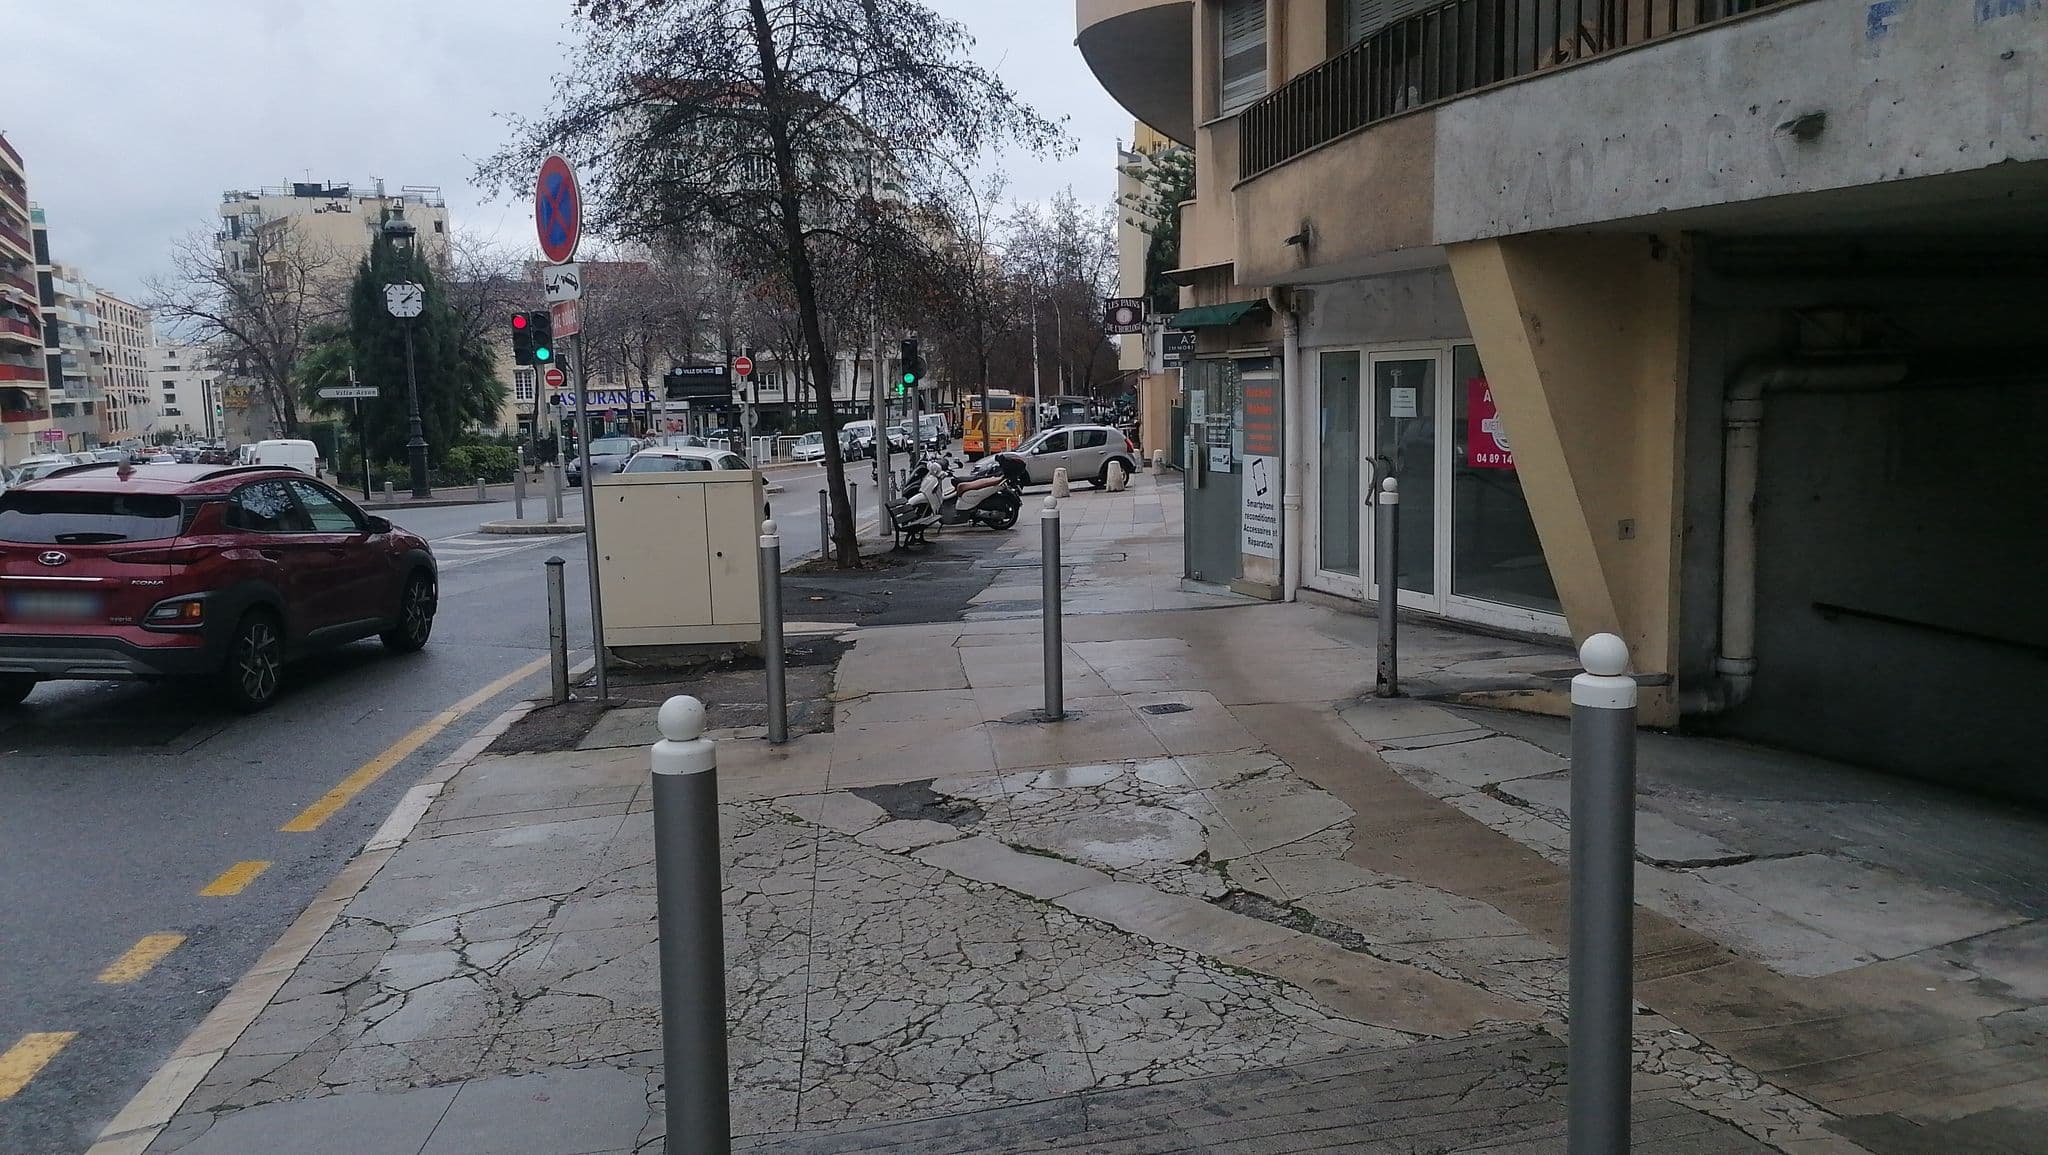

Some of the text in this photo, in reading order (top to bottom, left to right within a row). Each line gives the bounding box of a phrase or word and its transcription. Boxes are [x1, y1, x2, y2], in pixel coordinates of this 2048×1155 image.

[1107, 298, 1140, 309] LES PAINS
[1476, 453, 1512, 465] 04 89 14
[1246, 498, 1274, 511] Smartphone
[1243, 523, 1271, 536] Accessoires
